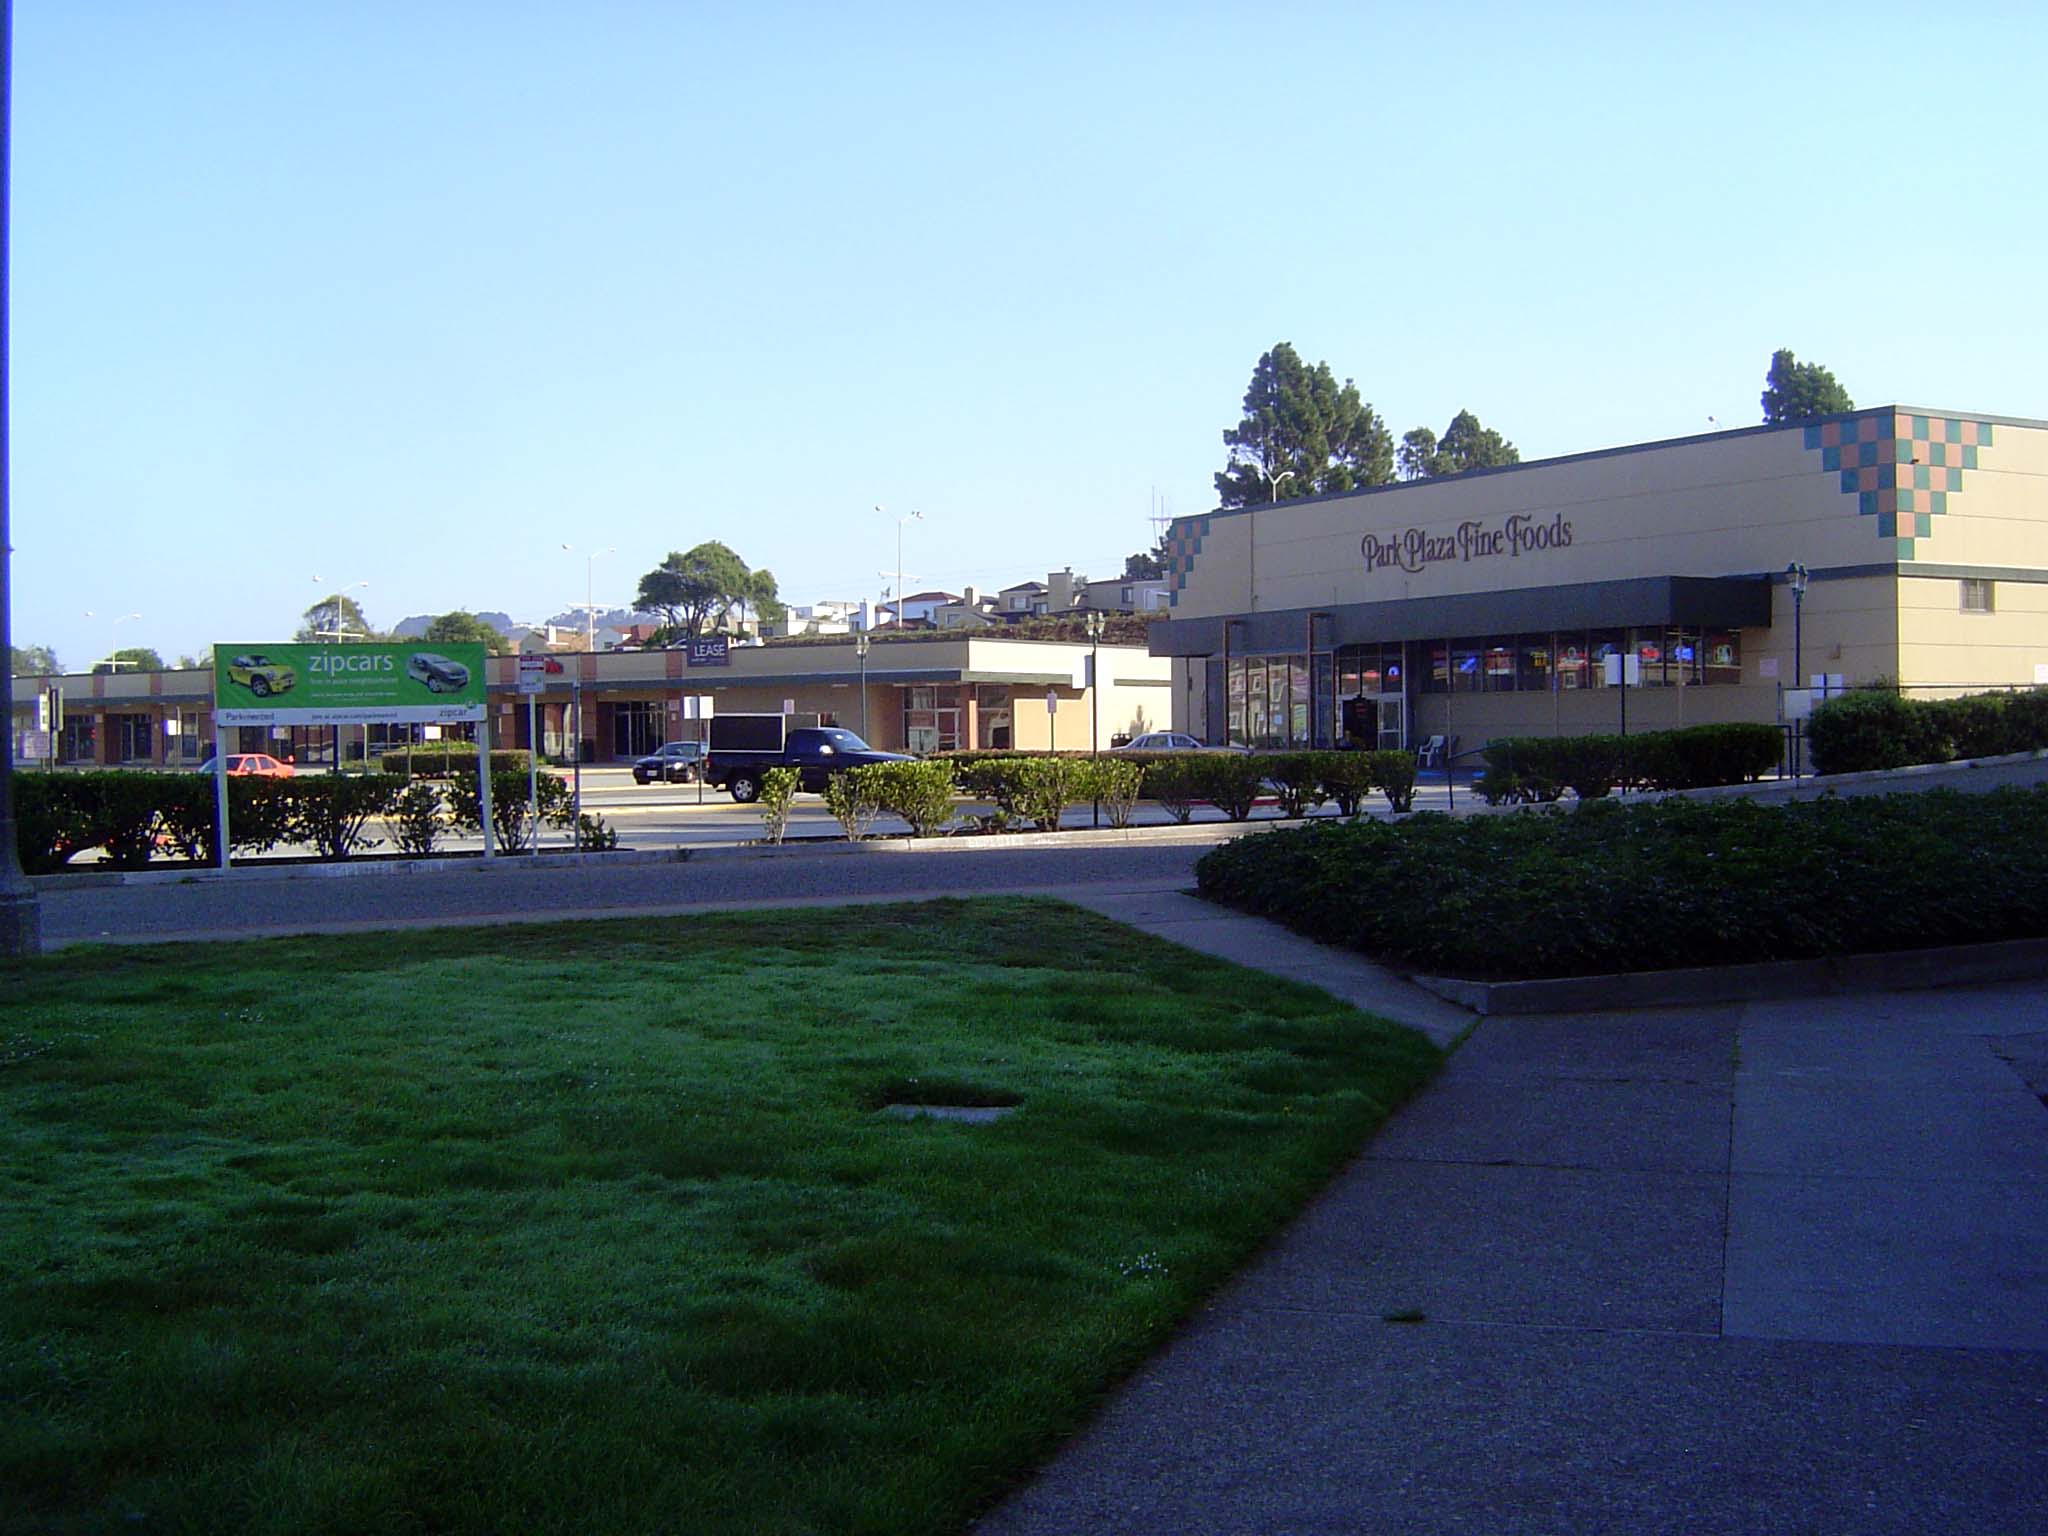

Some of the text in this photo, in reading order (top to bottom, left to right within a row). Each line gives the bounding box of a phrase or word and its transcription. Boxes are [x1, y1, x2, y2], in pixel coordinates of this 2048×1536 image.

[1361, 512, 1573, 572] Park Plaza Fine Foods
[694, 644, 726, 657] LEASE
[309, 650, 394, 677] zipcars
[439, 709, 468, 719] zipcar
